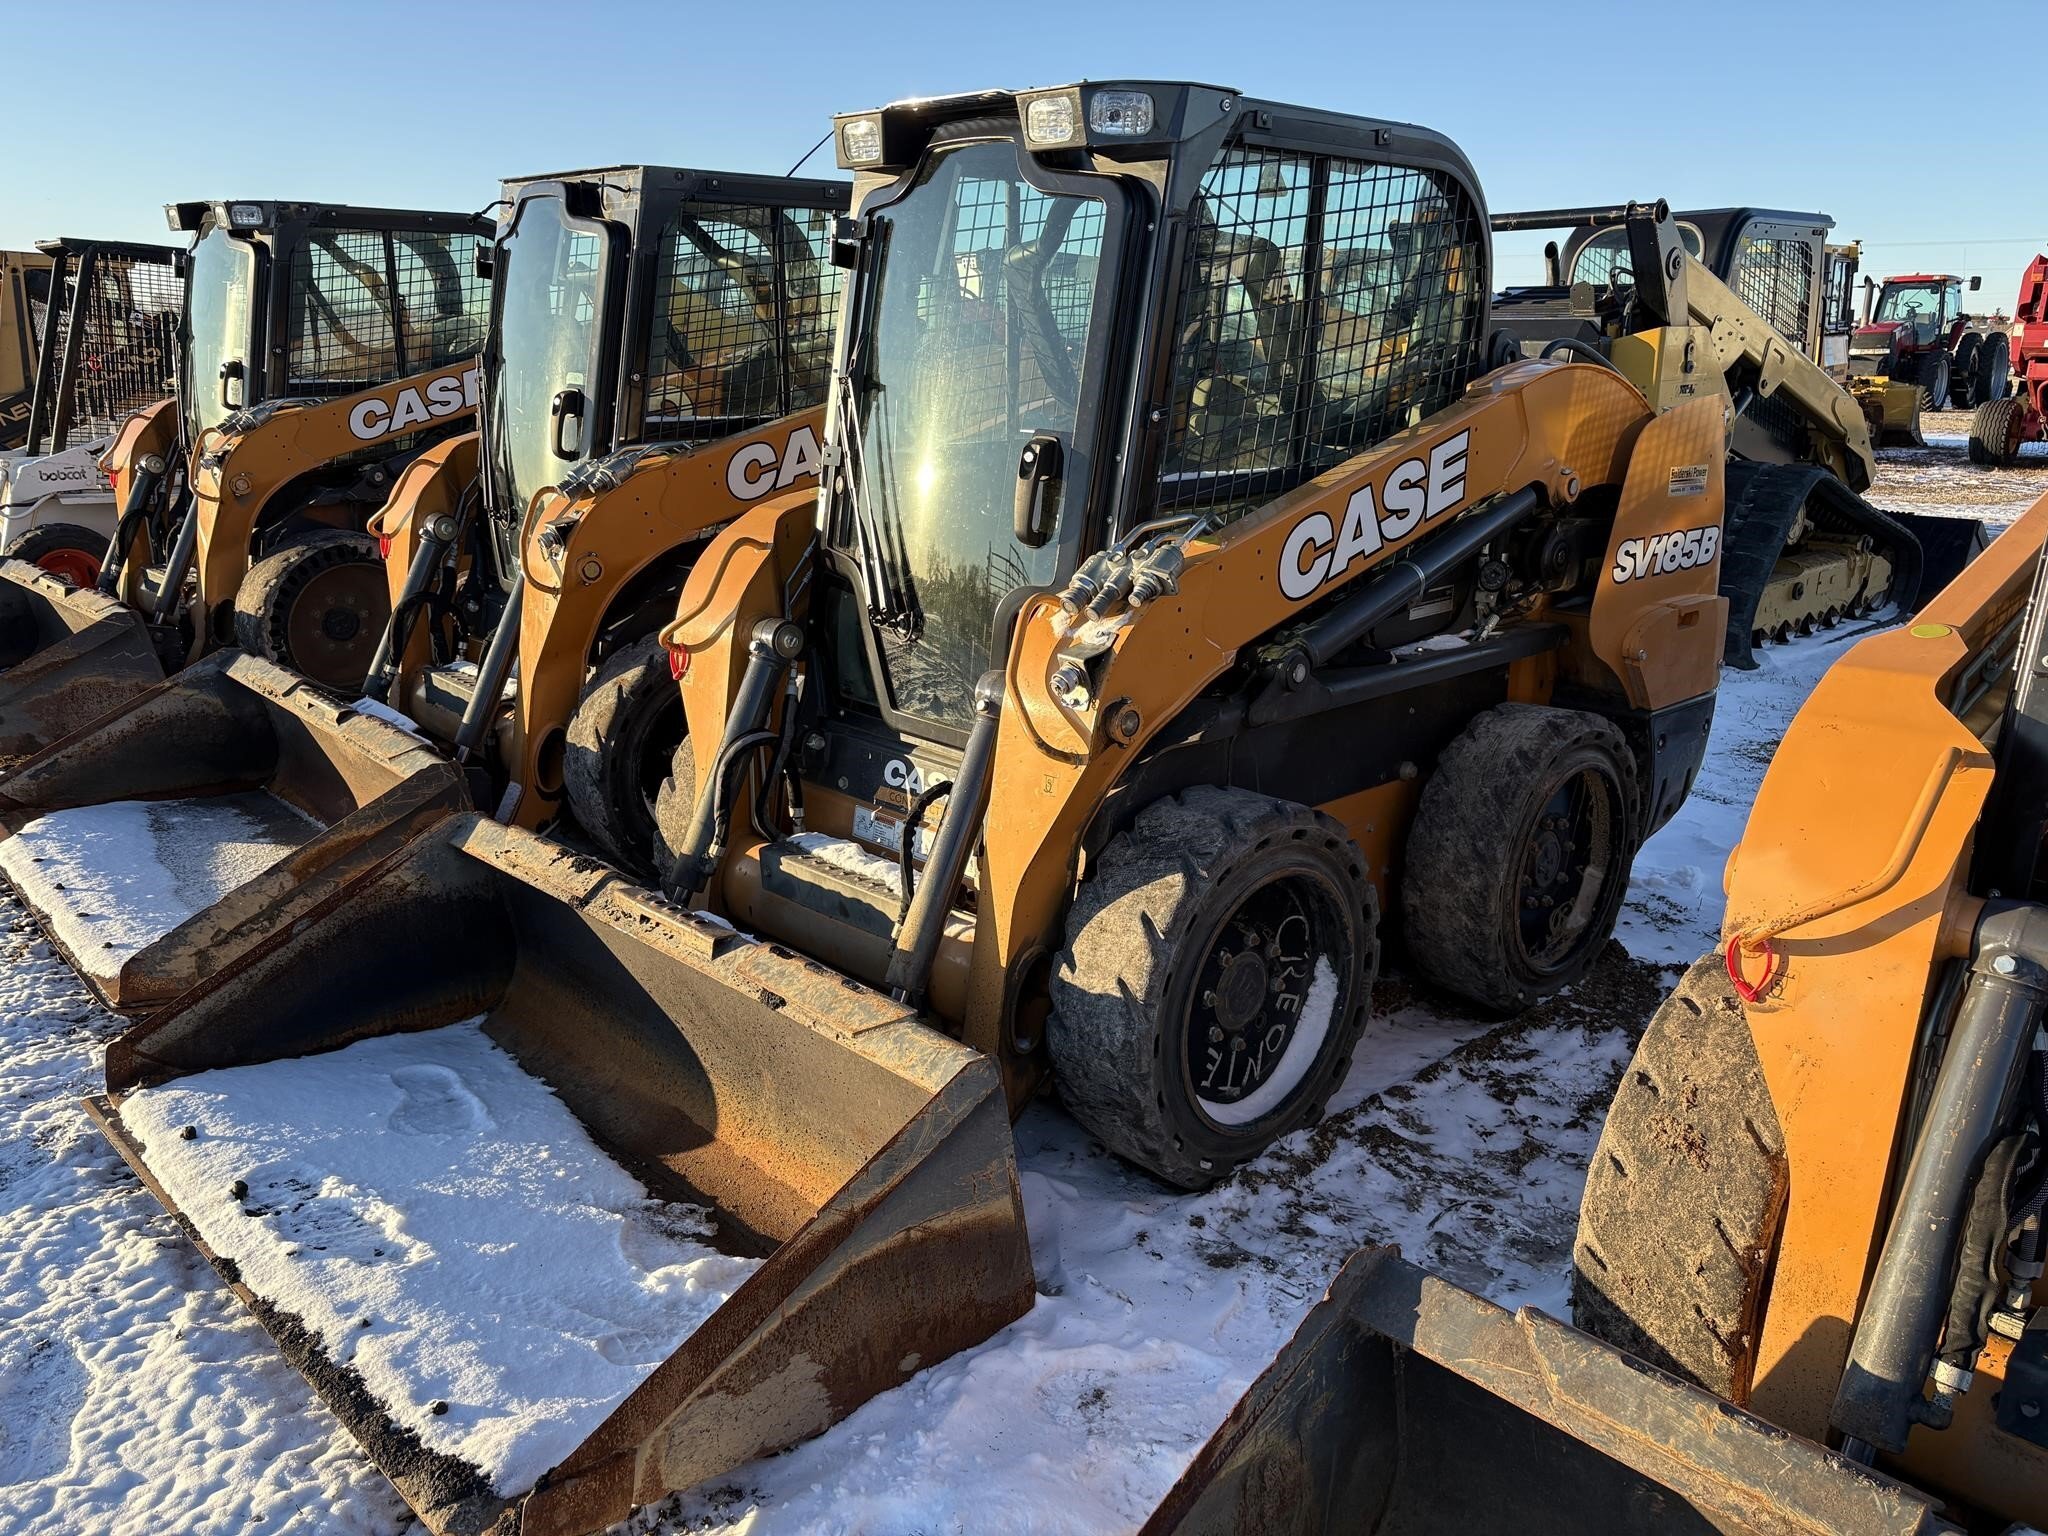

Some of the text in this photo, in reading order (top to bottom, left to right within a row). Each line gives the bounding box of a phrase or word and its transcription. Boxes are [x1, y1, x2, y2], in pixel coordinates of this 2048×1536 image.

[0, 402, 33, 426] NE
[39, 468, 87, 481] bobcat
[726, 424, 821, 500] CA
[1278, 427, 1470, 601] CASE
[1613, 526, 1719, 583] SV185B
